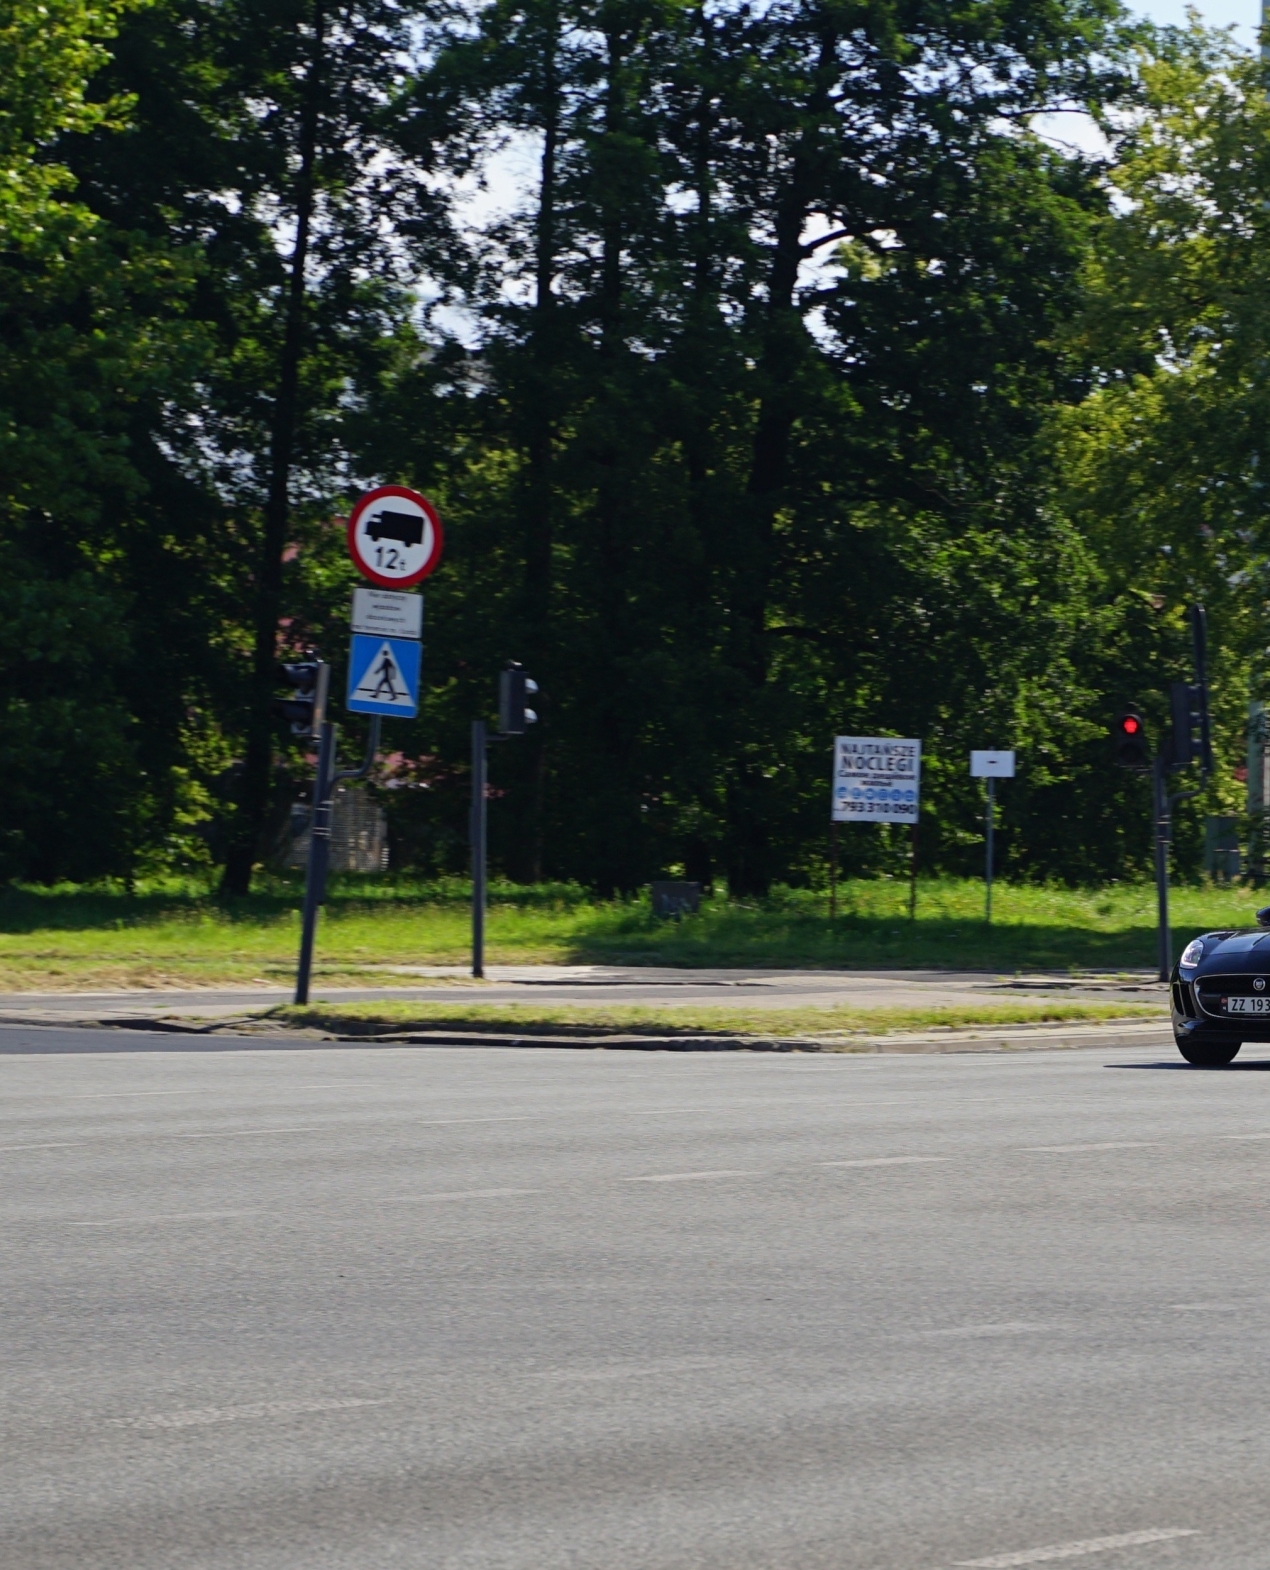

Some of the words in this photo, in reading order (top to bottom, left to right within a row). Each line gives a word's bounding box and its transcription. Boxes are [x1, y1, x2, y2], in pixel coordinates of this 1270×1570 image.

[840, 743, 916, 757] NAJTAŃSZE
[841, 756, 914, 772] NOCLEGI
[1231, 998, 1246, 1012] ZZ
